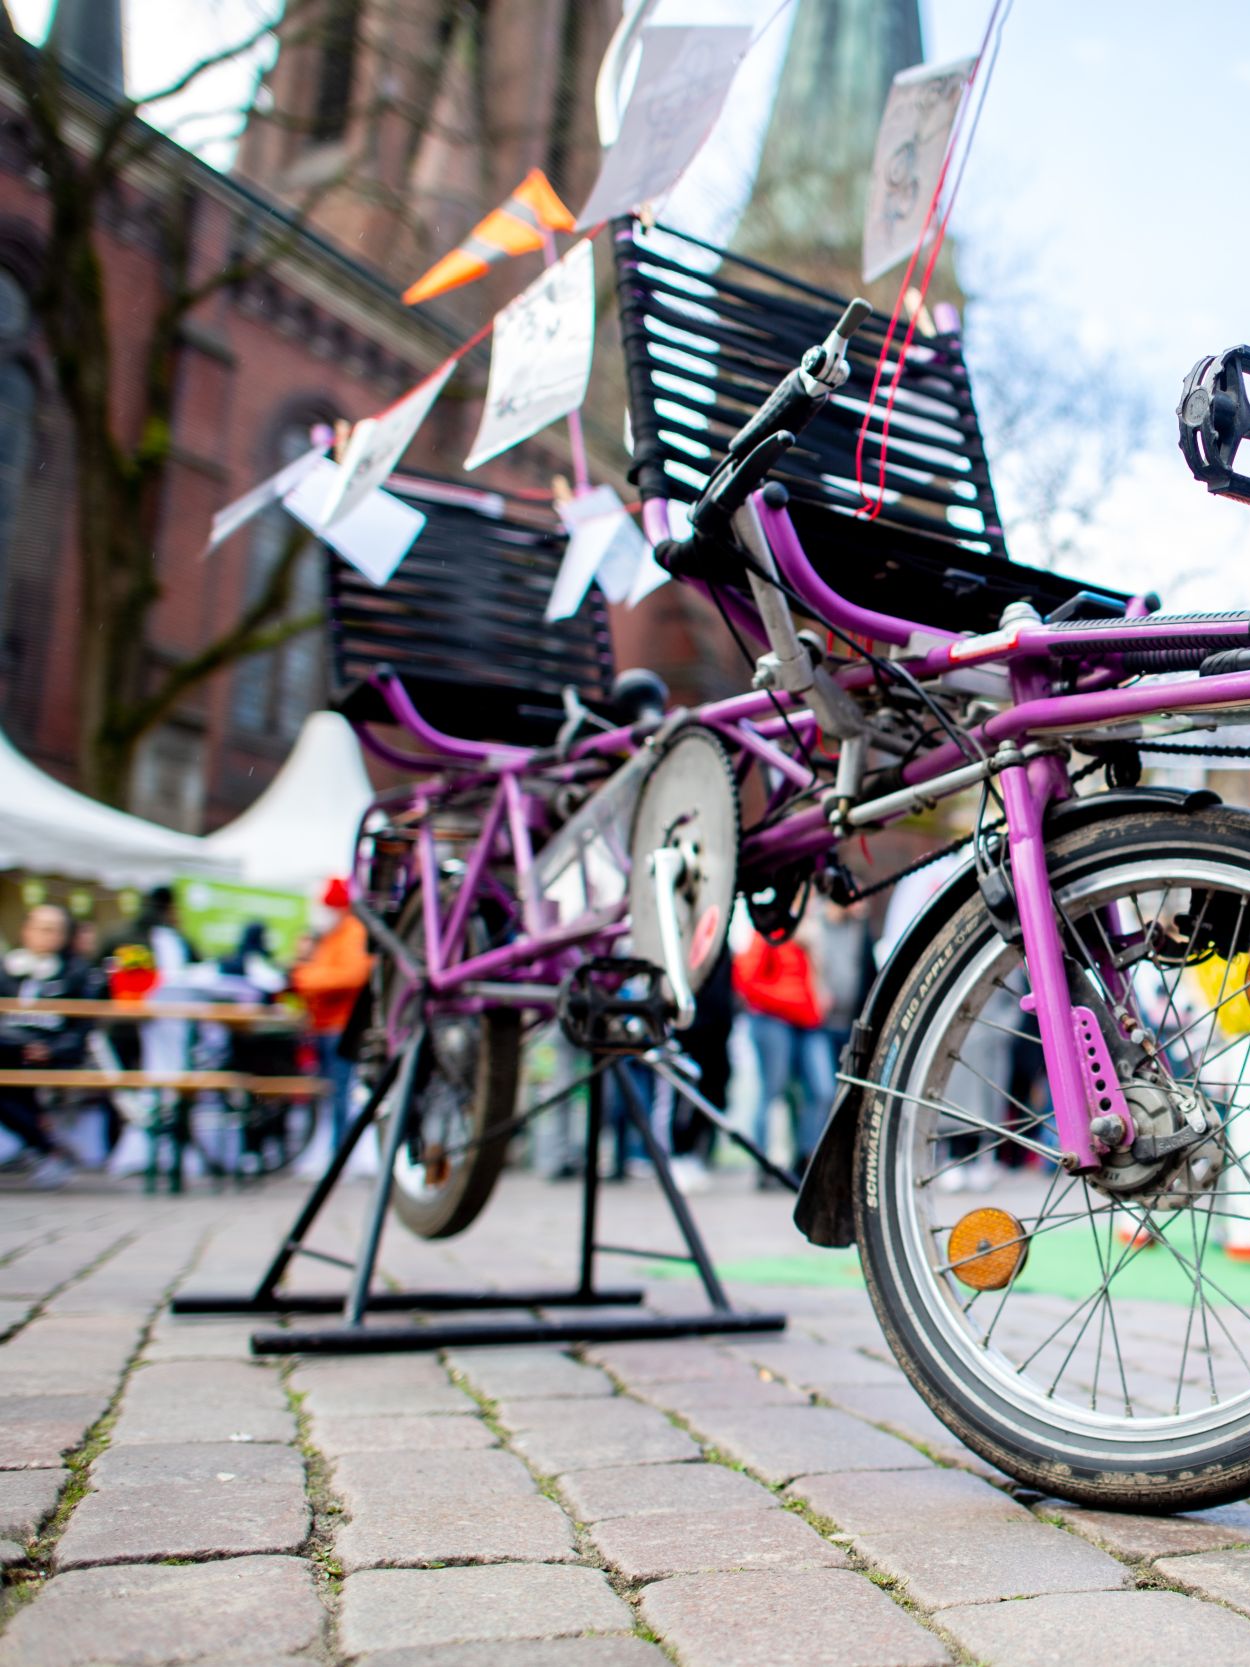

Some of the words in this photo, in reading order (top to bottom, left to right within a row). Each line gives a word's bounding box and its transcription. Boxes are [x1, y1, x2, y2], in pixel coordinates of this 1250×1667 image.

[900, 998, 919, 1031] BIG
[920, 944, 954, 998] APPLE
[866, 1100, 884, 1209] SCHWALBE
